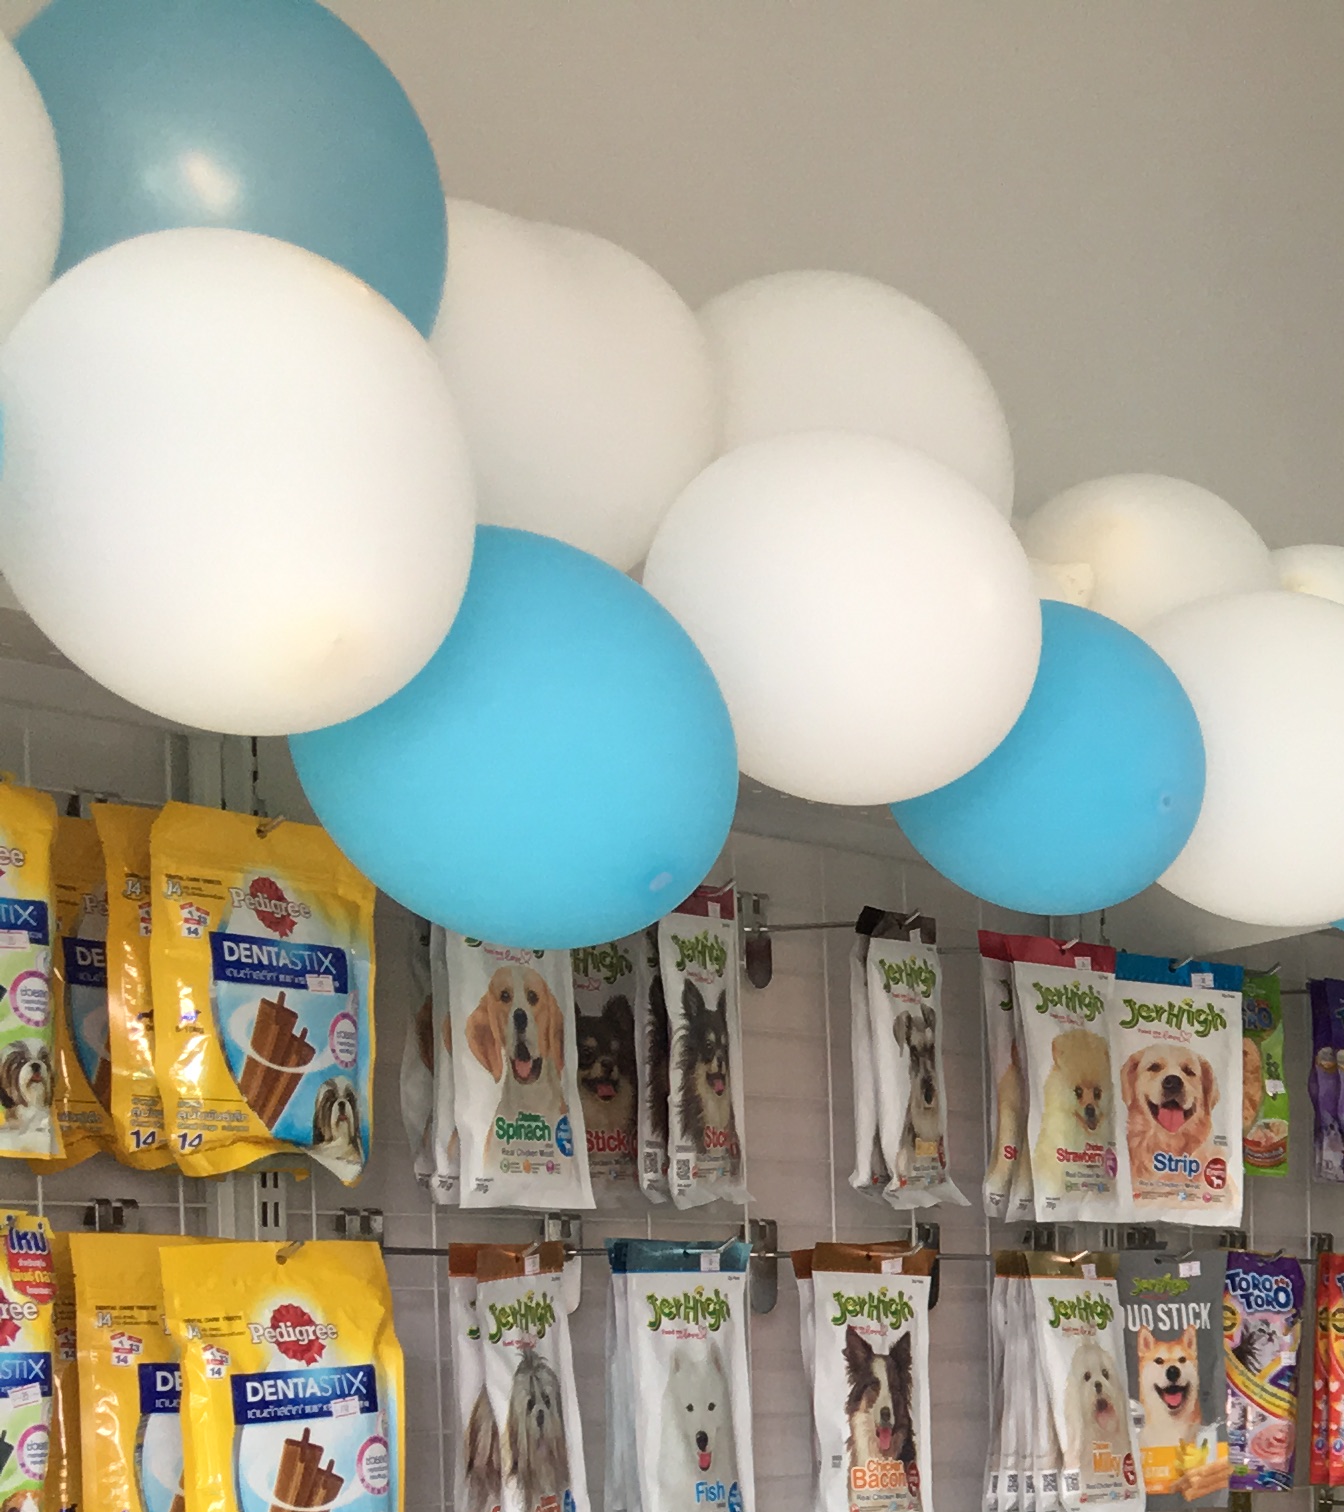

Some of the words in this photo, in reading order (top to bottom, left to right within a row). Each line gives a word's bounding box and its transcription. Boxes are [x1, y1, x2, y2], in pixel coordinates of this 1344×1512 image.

[229, 887, 311, 918] Pedigree
[223, 941, 337, 974] DENTASTIX
[1119, 998, 1227, 1037] JerHigh
[130, 1131, 155, 1148] 14
[177, 1133, 202, 1150] 14
[495, 1117, 552, 1145] Spinach
[586, 1130, 627, 1152] Stick
[1153, 1153, 1199, 1176] Strip
[8, 1223, 48, 1254] ใหม่
[489, 1292, 556, 1343] JerHigh
[647, 1287, 731, 1331] JerHigh
[832, 1288, 914, 1330] JerHigh
[1048, 1292, 1114, 1330] JerHigh
[1157, 1303, 1211, 1331] STICK
[249, 1321, 337, 1344] Pedigree
[246, 1372, 364, 1402] DENTASTIX
[696, 1482, 725, 1503] Fish
[851, 1469, 907, 1490] Bacon
